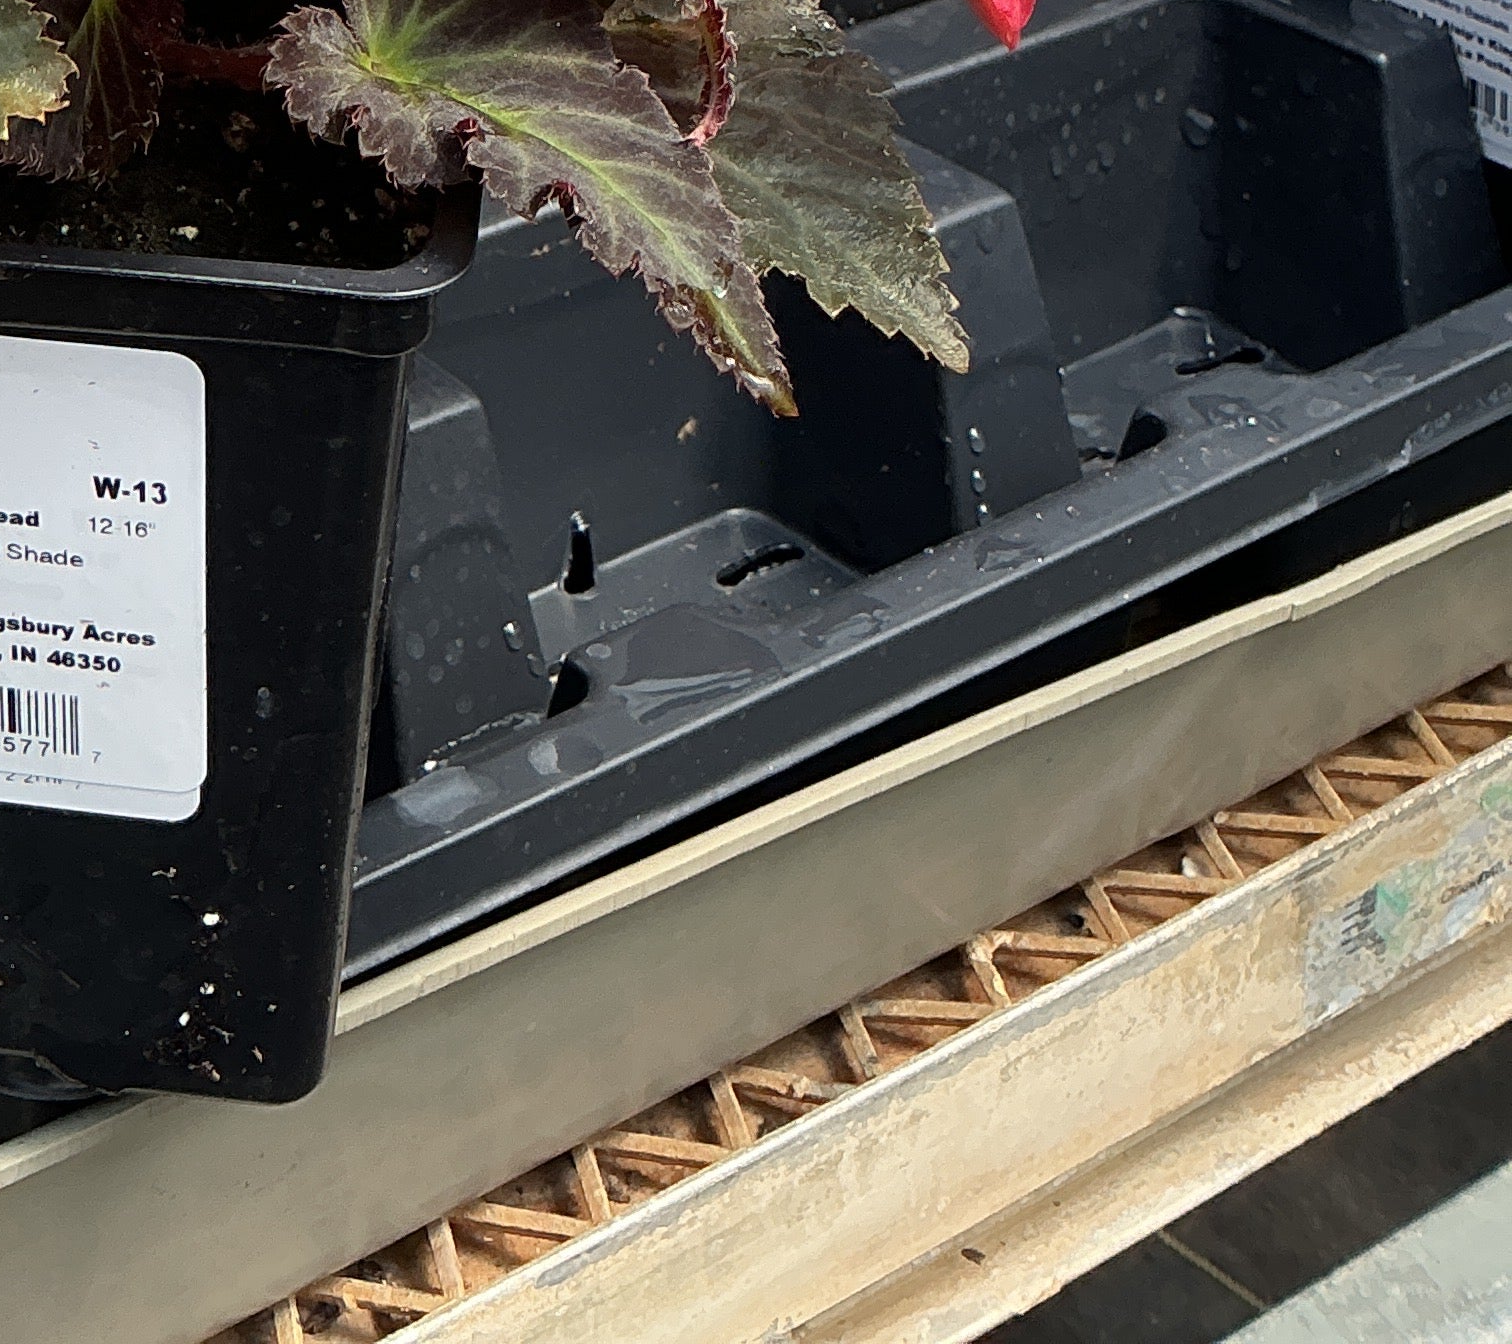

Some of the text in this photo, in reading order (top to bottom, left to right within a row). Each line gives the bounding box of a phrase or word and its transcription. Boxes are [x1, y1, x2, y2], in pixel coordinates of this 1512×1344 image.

[93, 476, 168, 504] W-13
[6, 543, 84, 567] Shade
[83, 624, 156, 646] Acres
[11, 645, 37, 662] IN
[47, 650, 121, 672] 46350
[91, 751, 101, 763] 7
